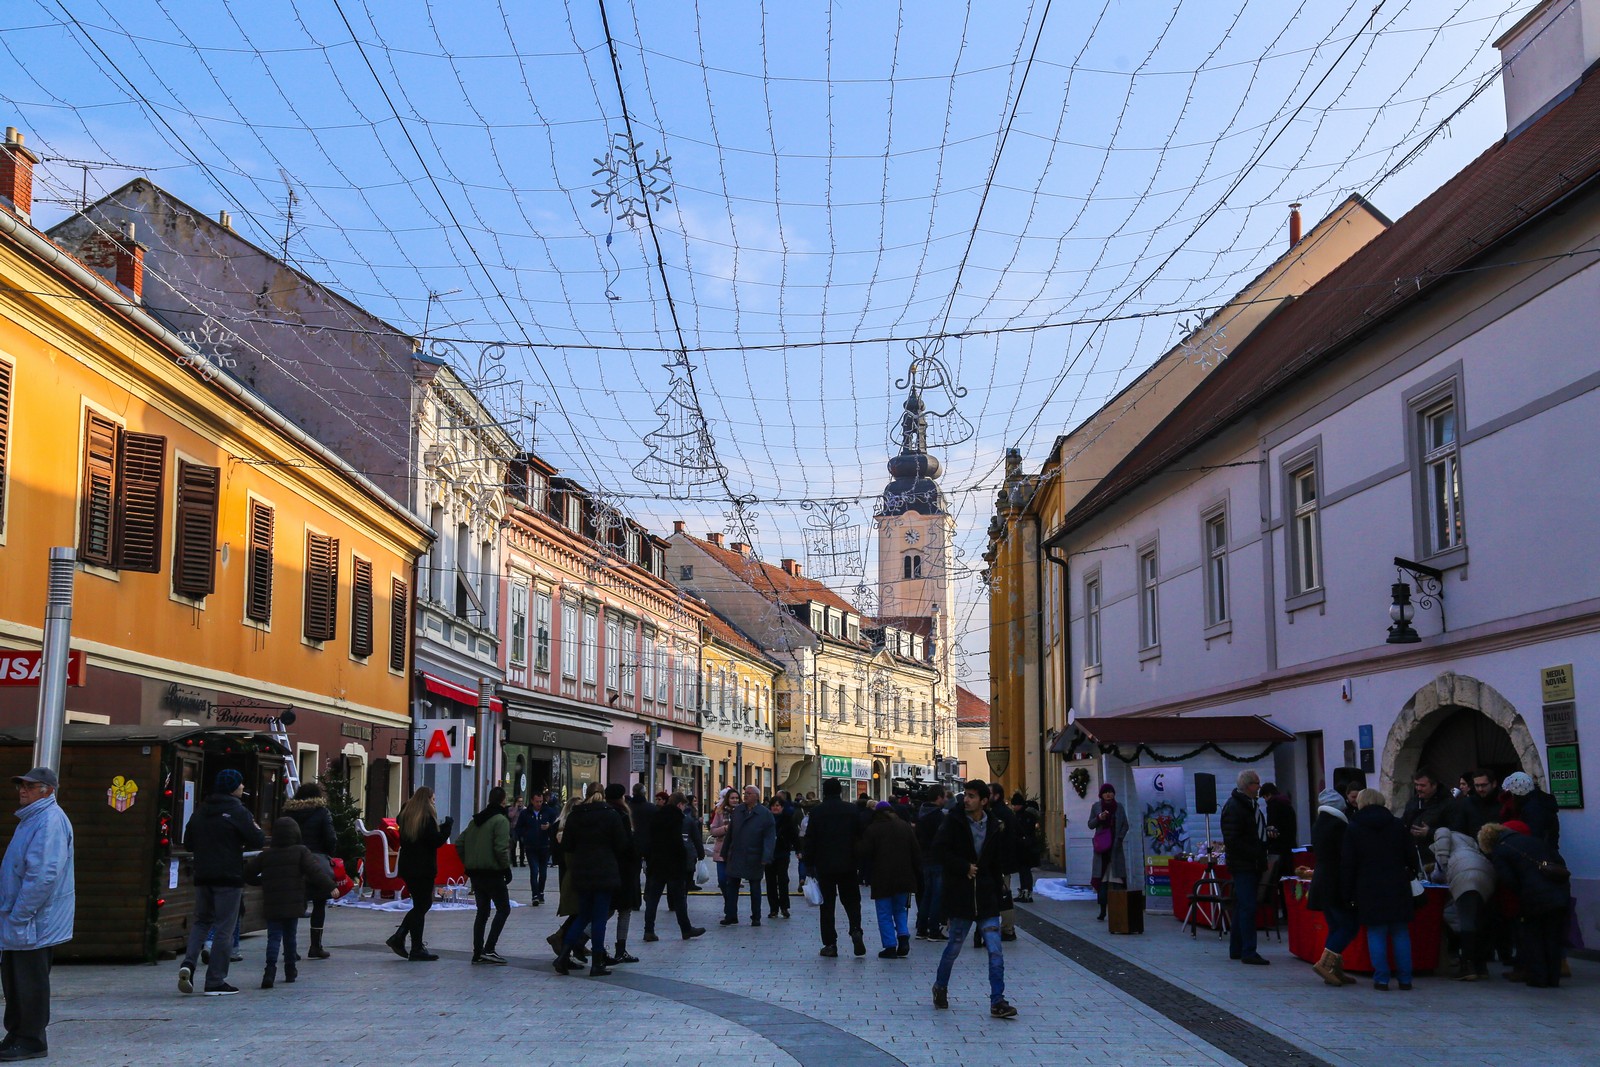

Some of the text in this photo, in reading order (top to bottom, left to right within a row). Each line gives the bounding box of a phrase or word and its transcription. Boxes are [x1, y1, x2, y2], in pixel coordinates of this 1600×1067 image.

[1546, 669, 1565, 679] MEDIA
[1546, 676, 1567, 686] NOVINE
[1551, 770, 1577, 780] KREDITI
